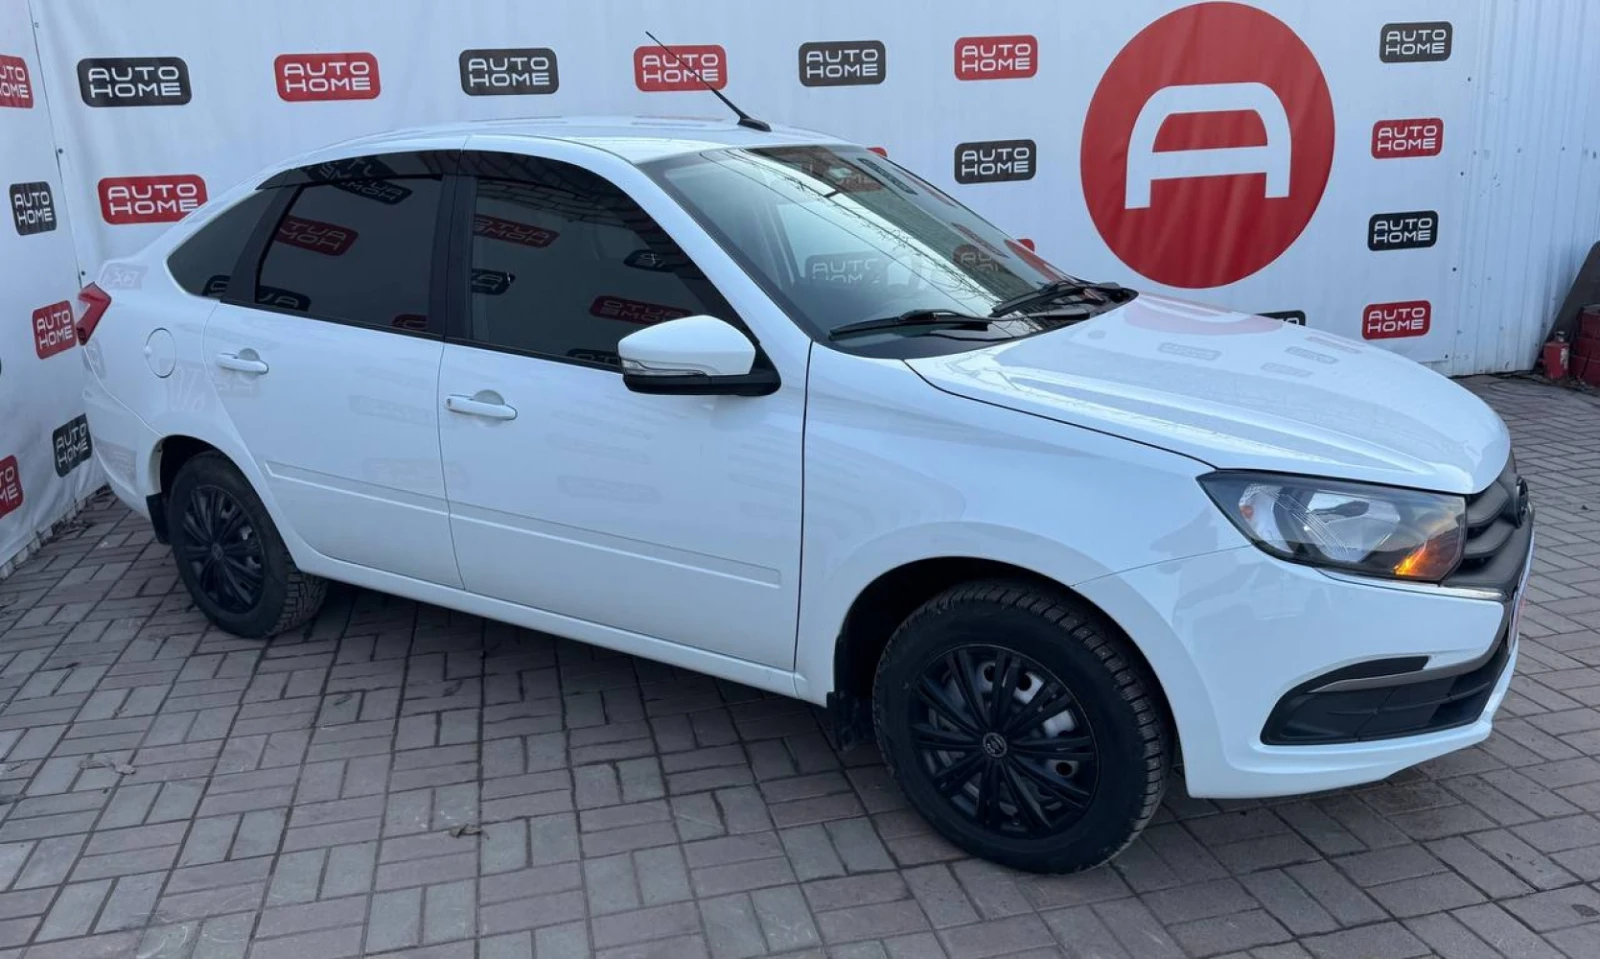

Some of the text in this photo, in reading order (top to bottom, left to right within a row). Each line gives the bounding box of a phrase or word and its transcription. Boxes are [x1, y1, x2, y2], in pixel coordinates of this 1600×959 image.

[1386, 28, 1447, 42] AUTO
[806, 49, 878, 63] AUTO
[962, 44, 1031, 58] AUTO
[1385, 42, 1445, 56] HOME
[468, 57, 549, 72] AUTO
[642, 53, 719, 68] AUTO
[961, 58, 1031, 72] HOME
[88, 65, 179, 82] AUTO
[284, 61, 370, 77] AUTO
[642, 68, 719, 83] HOME
[806, 63, 878, 79] HOME
[285, 77, 371, 92] HOME
[469, 72, 550, 87] HOME
[0, 82, 29, 98] OME
[90, 82, 182, 99] HOME
[1378, 124, 1438, 138] AUTO
[1377, 137, 1436, 151] HOME
[962, 147, 1029, 162] AUTO
[961, 162, 1029, 176] HOME
[14, 190, 50, 207] AUTO
[108, 183, 198, 200] AUTO
[110, 199, 199, 216] HOME
[17, 207, 53, 225] HOME
[1375, 217, 1433, 231] AUTO
[1374, 230, 1432, 244] HOME
[36, 310, 71, 333] AUTO
[1368, 307, 1426, 322] AUTO
[1367, 319, 1424, 333] HOME
[39, 325, 73, 350] HOME
[56, 423, 87, 451] AUTO
[57, 437, 88, 468] HOME
